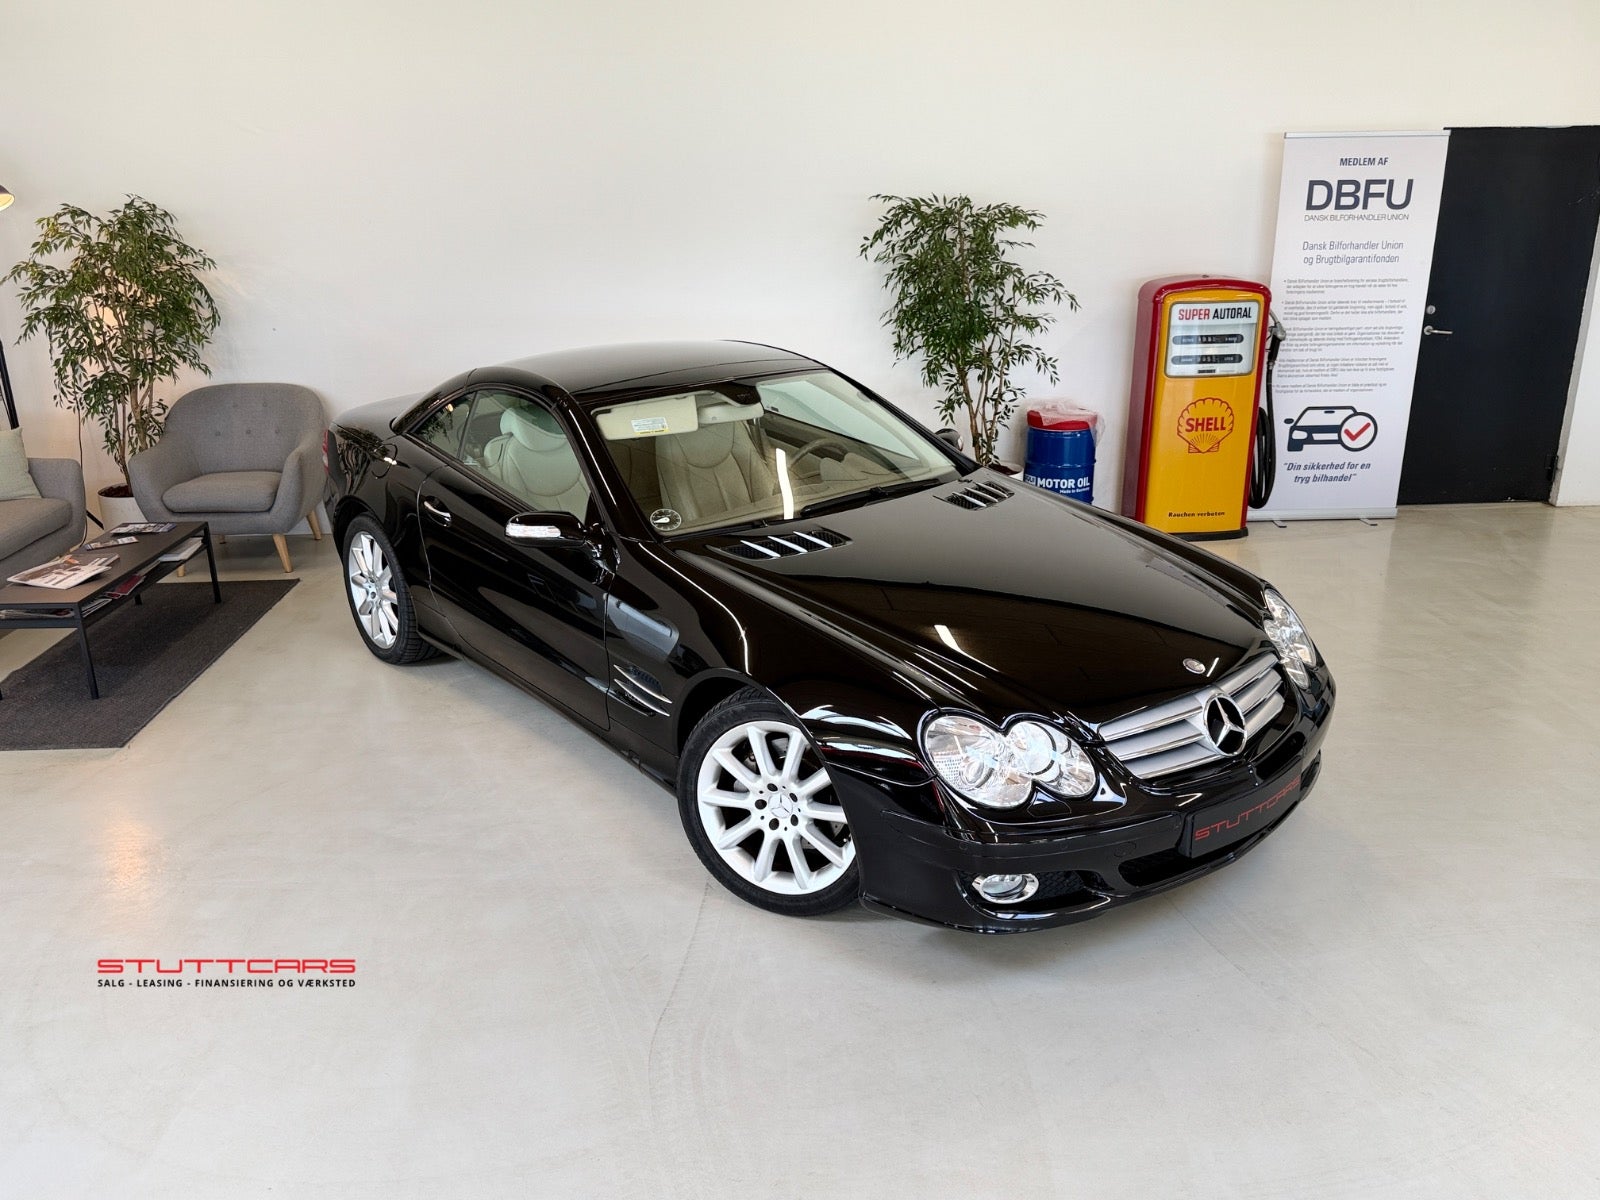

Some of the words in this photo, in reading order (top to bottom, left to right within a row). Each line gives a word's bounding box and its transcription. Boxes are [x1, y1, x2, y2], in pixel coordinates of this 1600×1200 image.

[1340, 157, 1376, 167] MEDLEM
[1378, 157, 1389, 166] AF
[1305, 178, 1414, 211] DBFU
[1304, 214, 1329, 222] DANSK
[1330, 213, 1388, 221] BILFORHANDLER
[1388, 213, 1410, 221] UNION
[1302, 240, 1327, 251] Dansk
[1329, 240, 1379, 251] Bilforhandler
[1381, 240, 1404, 250] Union
[1303, 256, 1314, 266] og
[1316, 254, 1400, 266] Brugtbilgarantifonden
[1178, 308, 1211, 321] SUPER
[1212, 306, 1252, 320] AUTORAL
[1185, 416, 1227, 433] SHELL
[1303, 461, 1345, 471] sikkerhed
[1346, 461, 1359, 470] for
[1037, 476, 1075, 489] MOTOR
[1077, 476, 1091, 488] OIL
[1293, 474, 1311, 484] tryg
